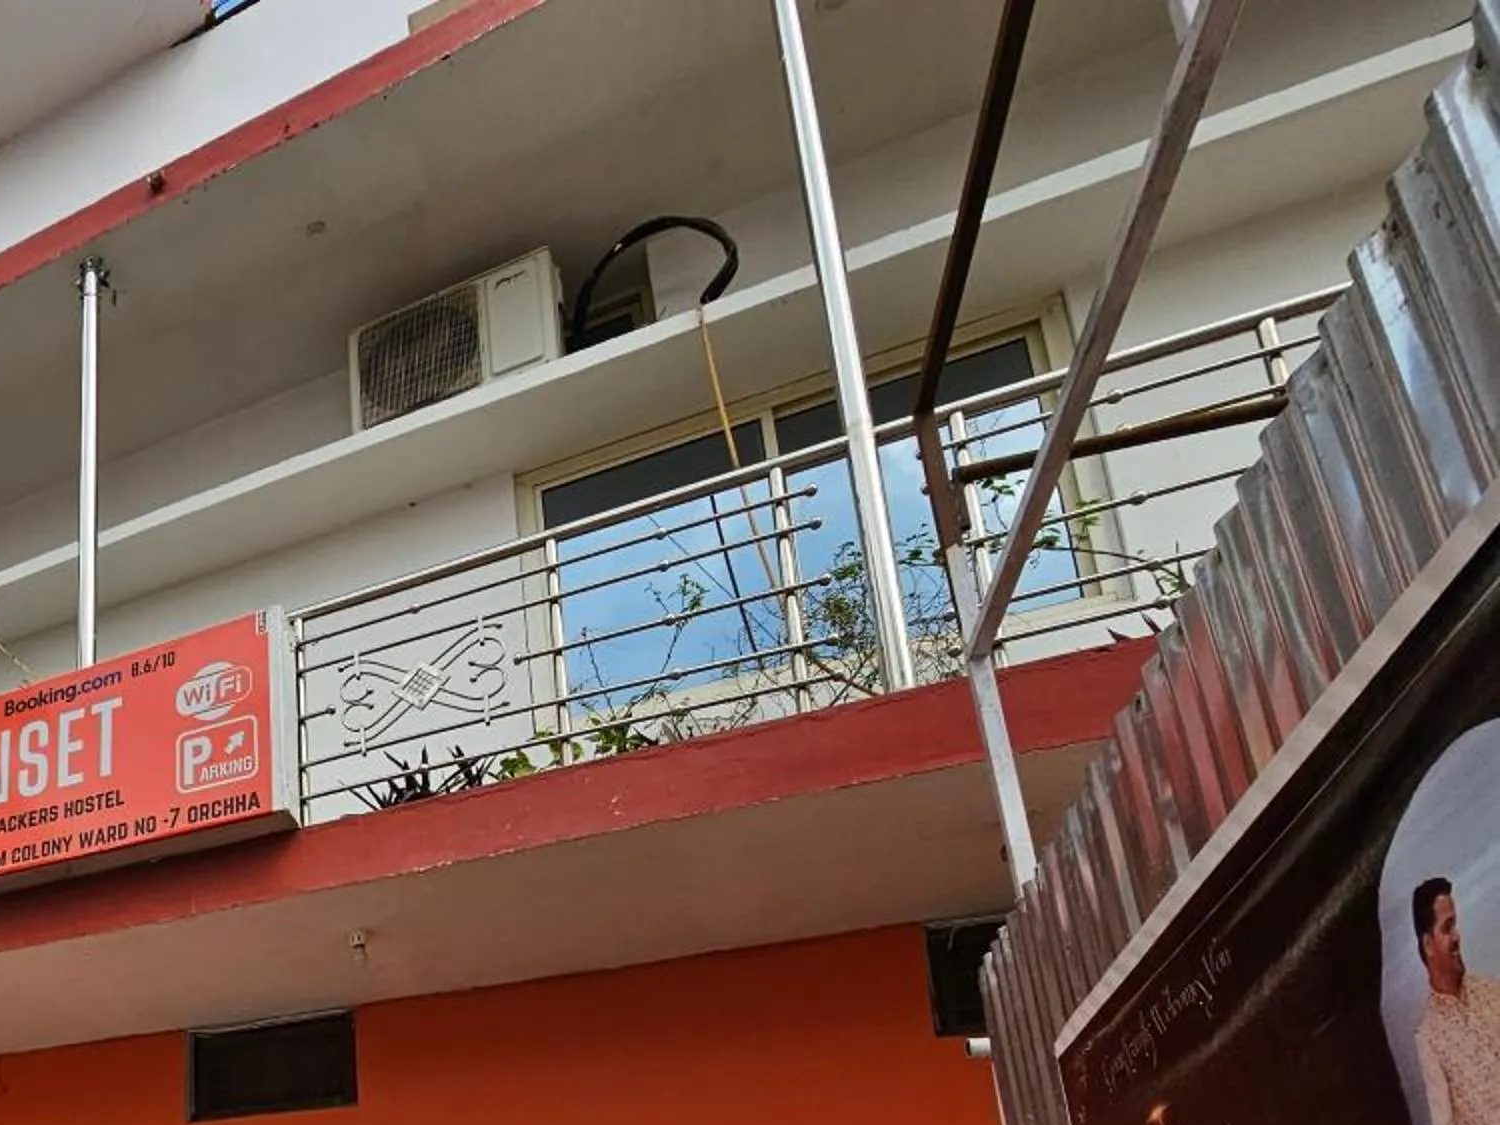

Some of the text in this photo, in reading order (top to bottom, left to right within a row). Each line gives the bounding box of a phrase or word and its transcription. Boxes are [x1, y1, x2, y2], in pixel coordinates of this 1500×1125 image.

[3, 651, 176, 718] Booking.com 8.6/10
[11, 836, 74, 864] COLONY
[78, 822, 129, 849] WARD
[133, 815, 157, 837] NO
[187, 791, 261, 824] ORCHHA
[64, 790, 125, 818] HOSTEL
